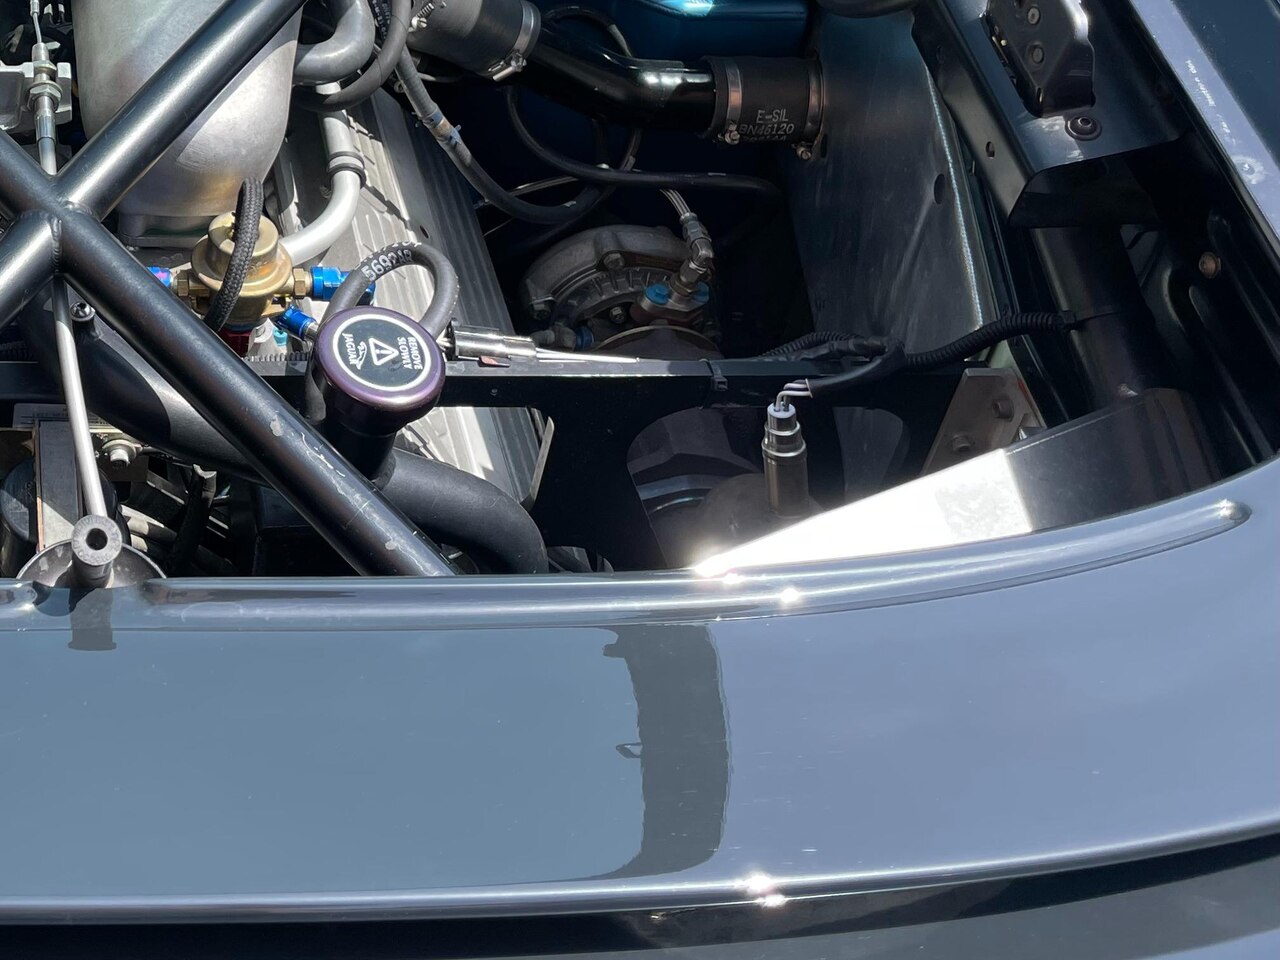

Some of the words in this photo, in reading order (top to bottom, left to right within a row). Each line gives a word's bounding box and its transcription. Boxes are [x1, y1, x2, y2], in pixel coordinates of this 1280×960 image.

[756, 109, 789, 124] E-SIL
[342, 333, 357, 365] JAGUAR
[397, 337, 413, 370] SLOWLY
[407, 337, 423, 370] REMOVE
